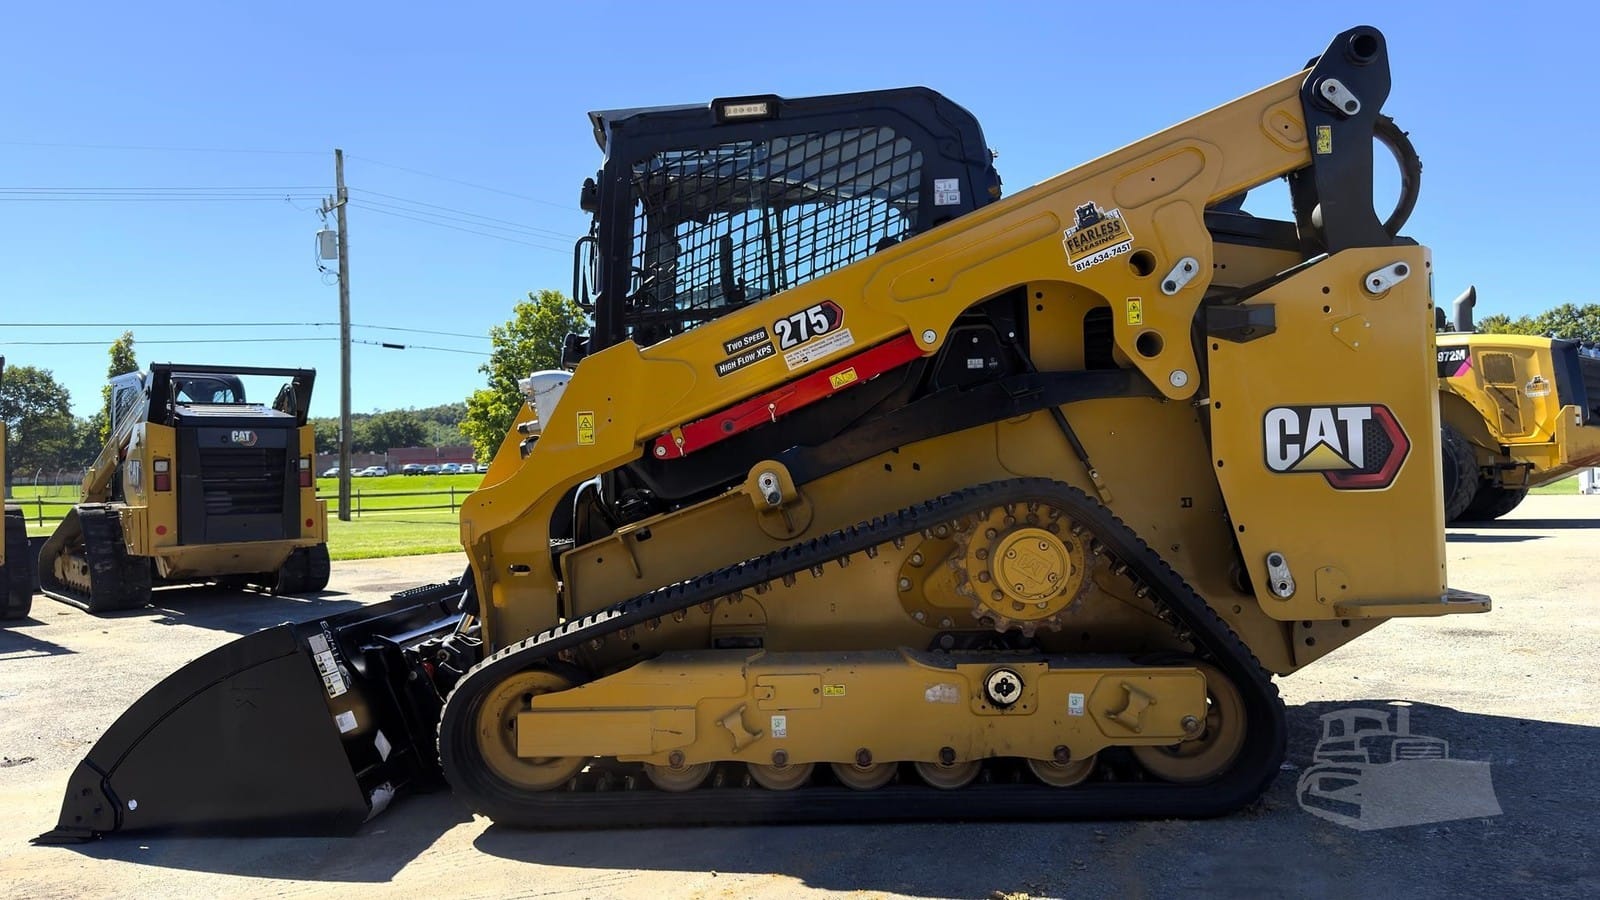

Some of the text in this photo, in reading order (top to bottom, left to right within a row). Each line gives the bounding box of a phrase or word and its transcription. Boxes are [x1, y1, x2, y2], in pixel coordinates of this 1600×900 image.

[1067, 220, 1121, 251] FEARLESS
[1080, 234, 1115, 252] LEASING
[1076, 243, 1130, 271] 814-634-7451
[774, 305, 829, 350] 275
[756, 345, 772, 358] XPS
[1437, 349, 1466, 362] 972M
[231, 430, 251, 443] CAT
[1264, 406, 1372, 471] CAT
